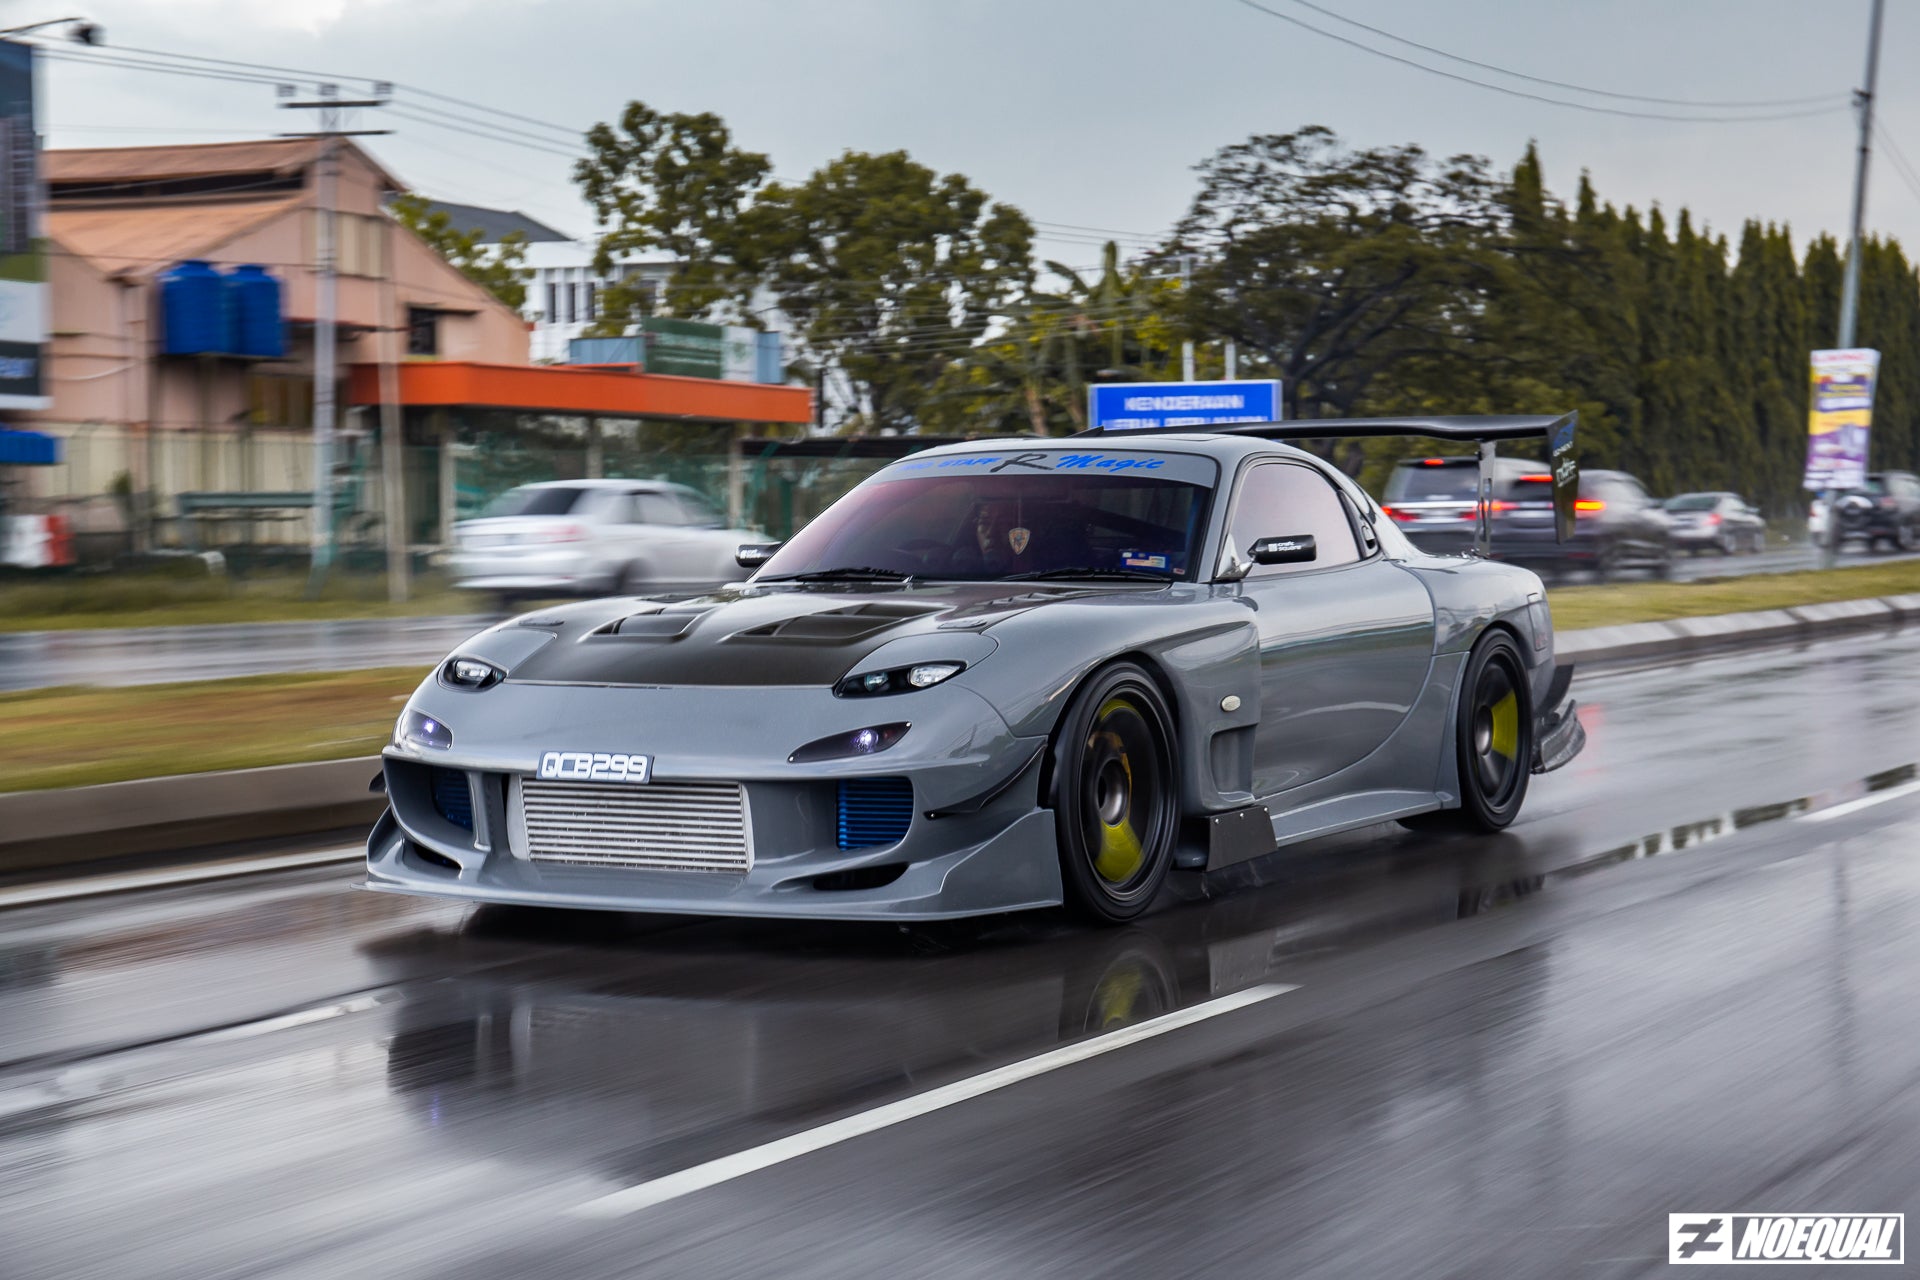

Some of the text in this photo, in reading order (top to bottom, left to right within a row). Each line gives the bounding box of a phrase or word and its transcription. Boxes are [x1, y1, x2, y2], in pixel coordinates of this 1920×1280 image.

[990, 453, 1054, 473] R
[1056, 454, 1166, 473] Magic
[541, 752, 649, 782] QCB299
